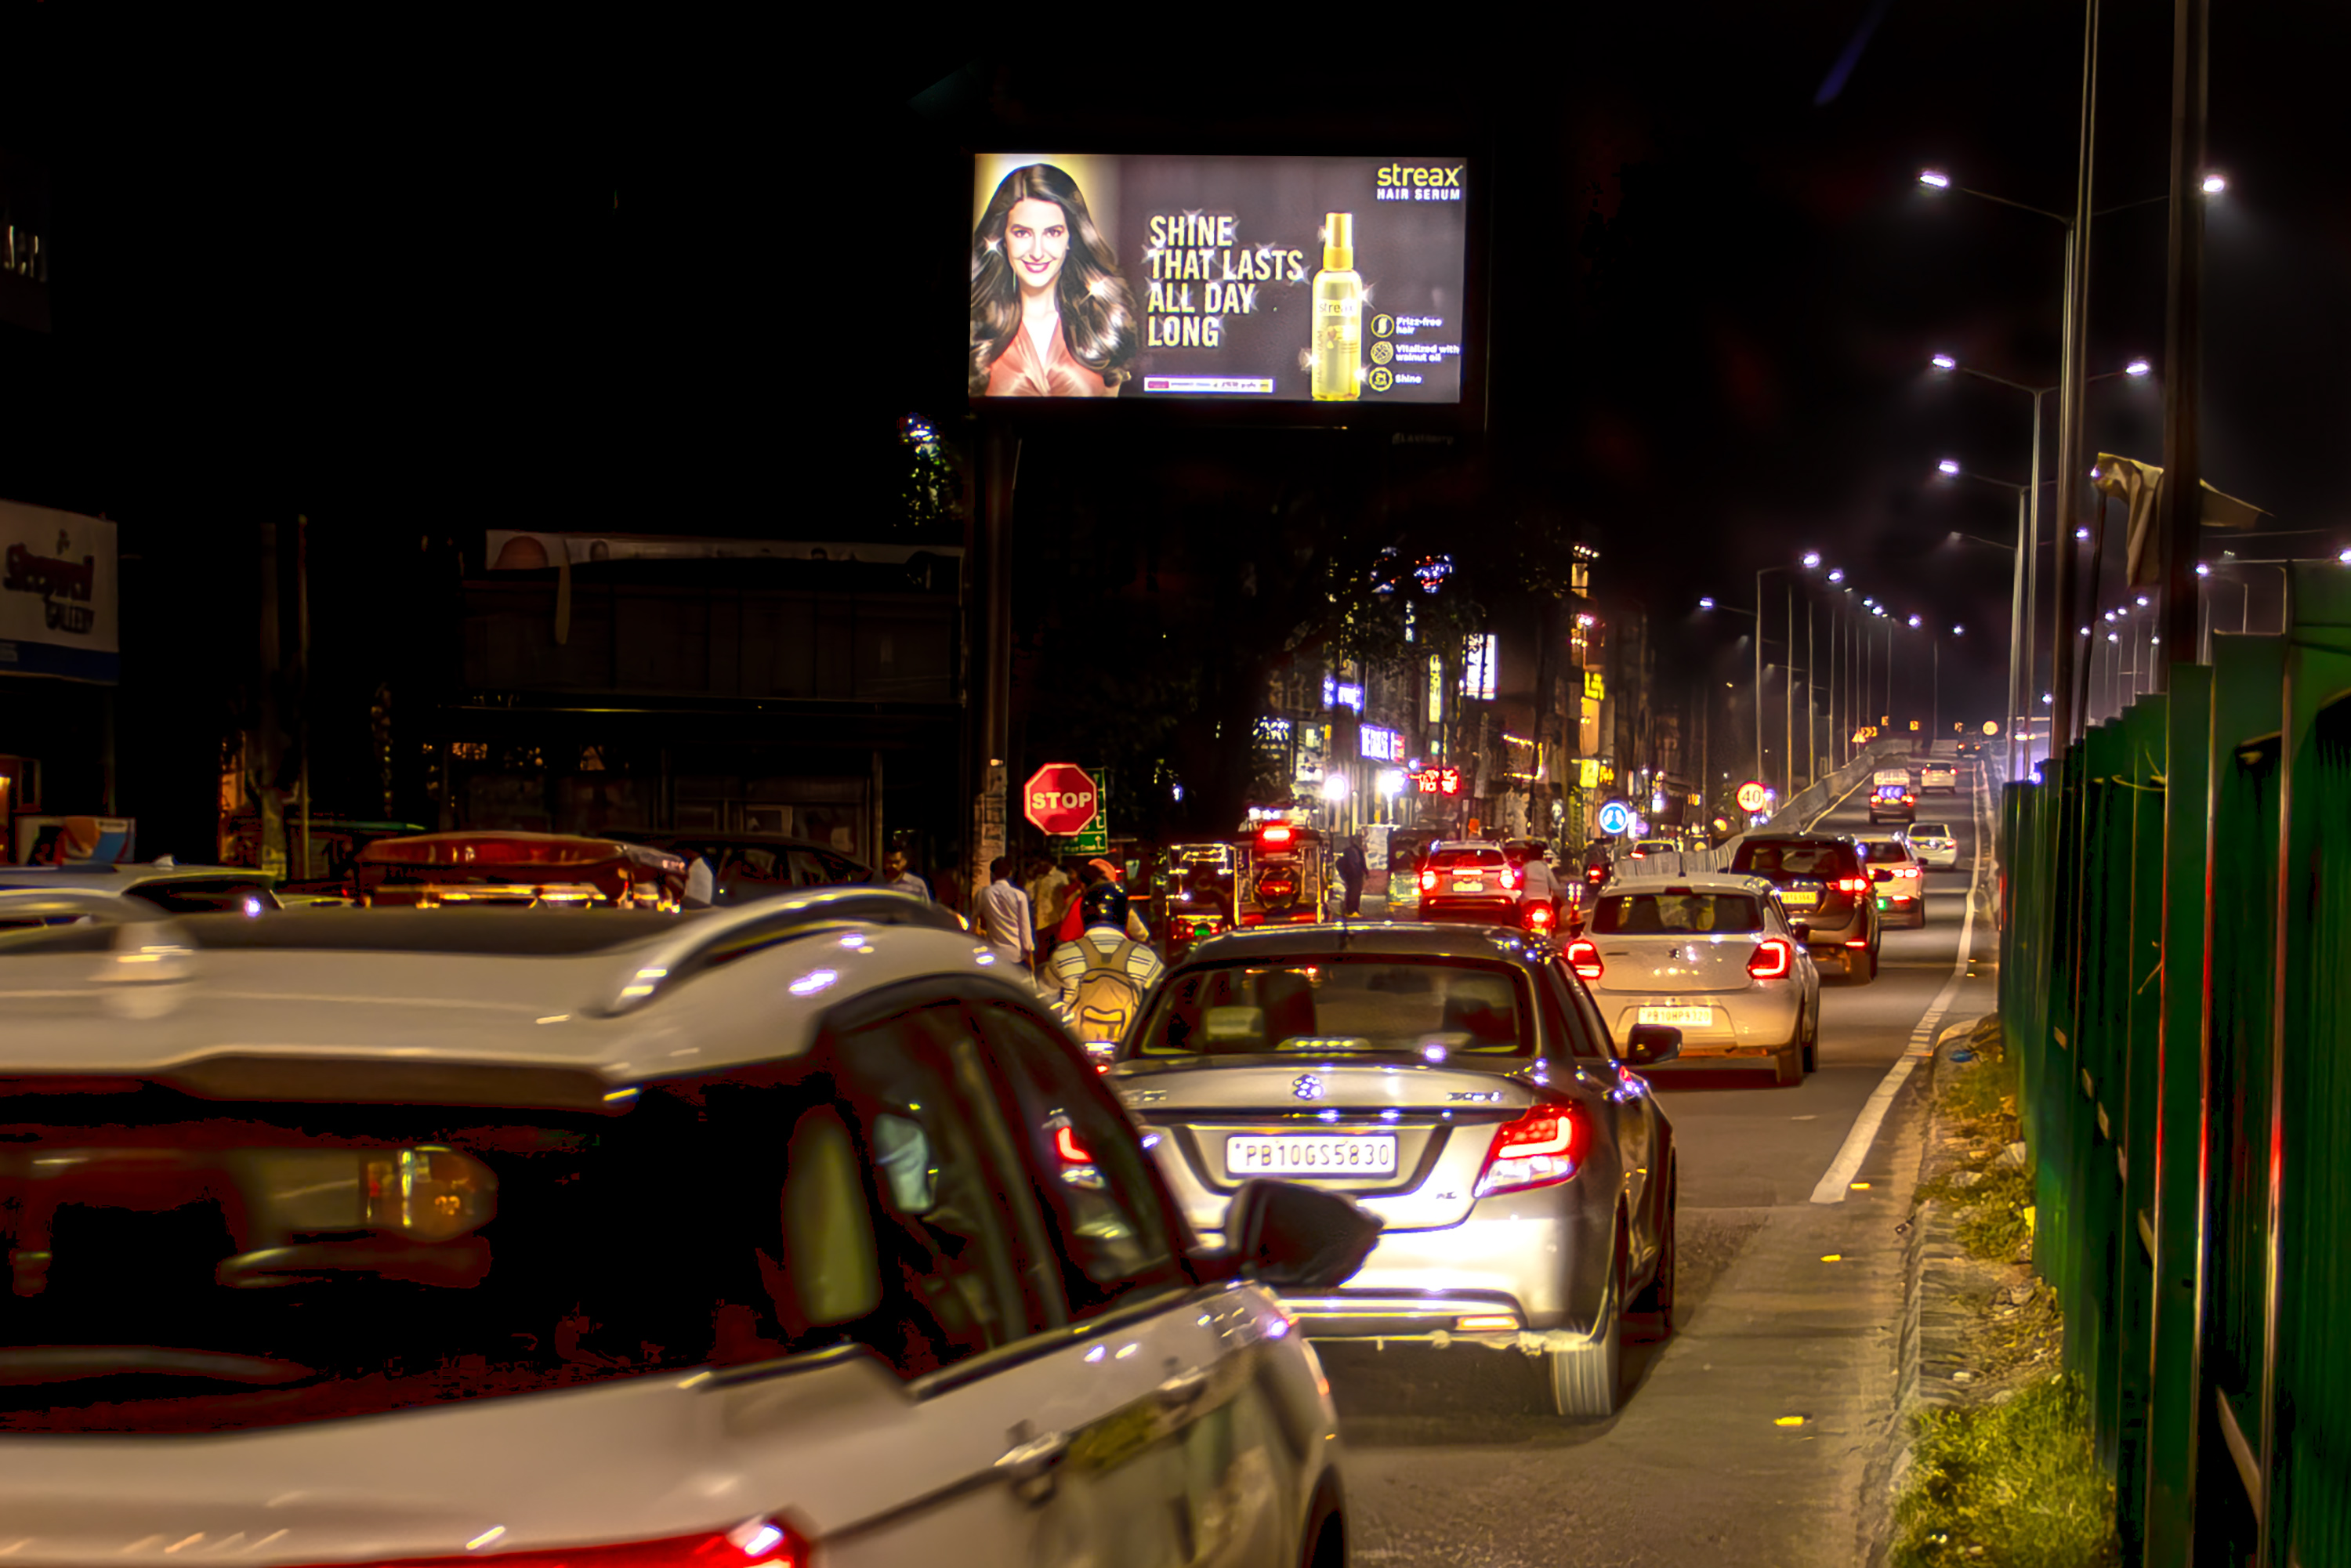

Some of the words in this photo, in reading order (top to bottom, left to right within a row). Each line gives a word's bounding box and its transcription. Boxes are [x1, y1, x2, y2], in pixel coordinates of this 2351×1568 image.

[1377, 163, 1460, 186] streax
[1377, 188, 1409, 200] HAIR
[1415, 188, 1460, 201] SERUM
[1150, 215, 1233, 247] SHINE
[1147, 249, 1215, 280] THAT
[1223, 249, 1304, 281] LASTS
[1148, 282, 1195, 313] ALL
[1204, 283, 1255, 313] DAY
[1148, 316, 1219, 347] LONG
[1396, 326, 1415, 335] hair
[1396, 353, 1428, 362] walnut
[1429, 353, 1442, 362] oil
[1439, 345, 1460, 354] with
[1395, 374, 1422, 384] Shine
[1032, 791, 1092, 809] STOP
[1742, 790, 1761, 804] 40
[1245, 1144, 1389, 1167] PB10GS5830
